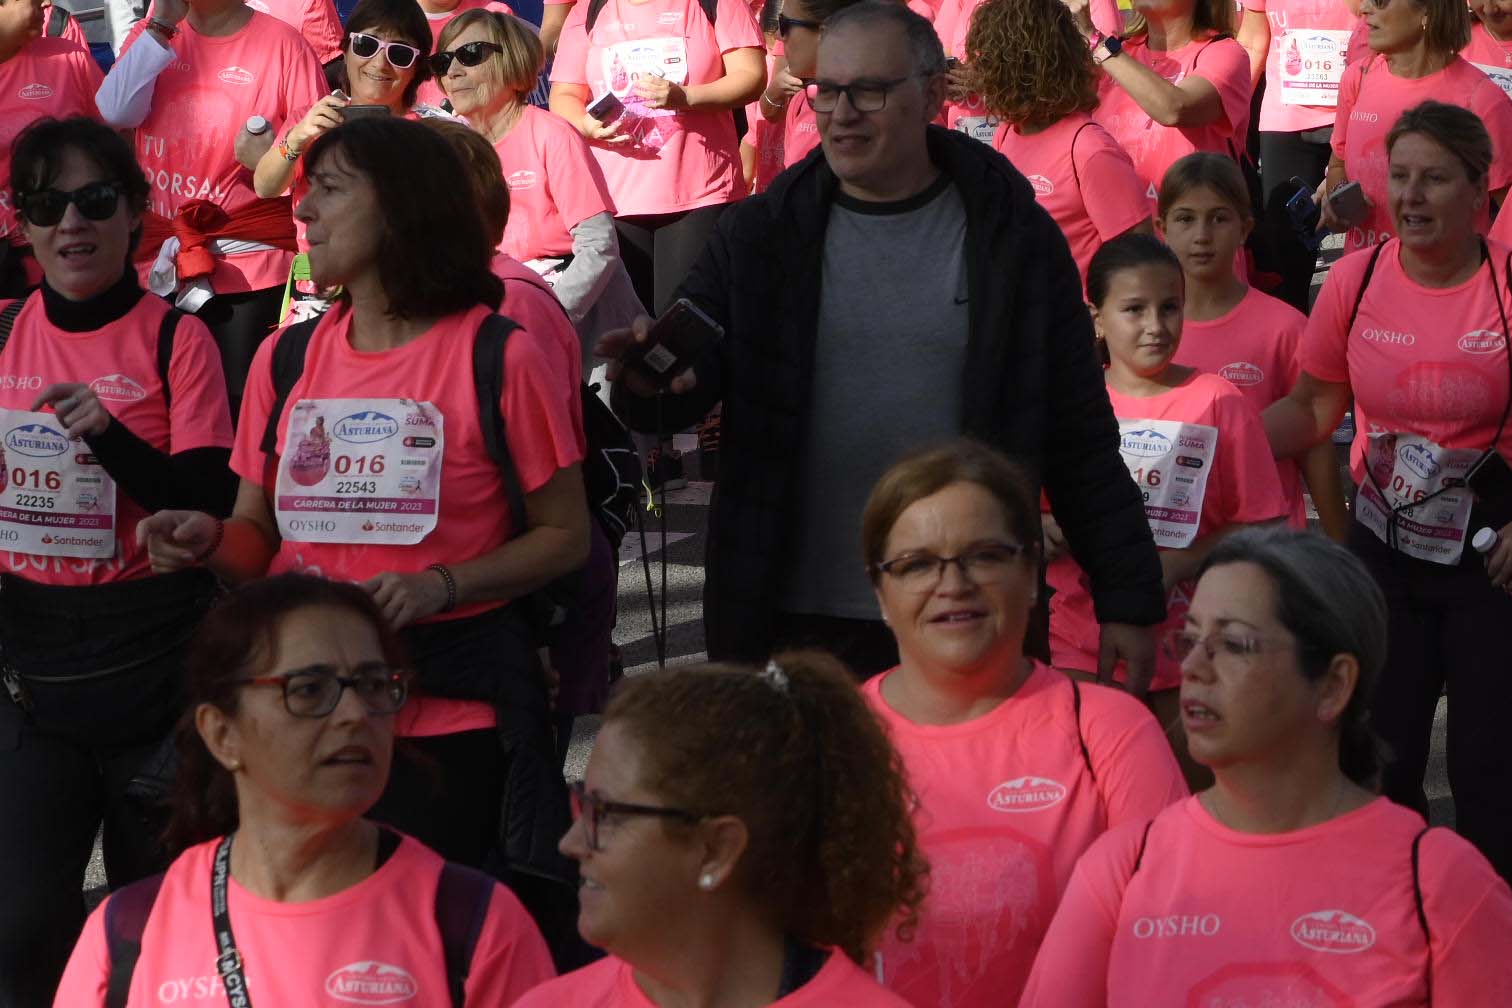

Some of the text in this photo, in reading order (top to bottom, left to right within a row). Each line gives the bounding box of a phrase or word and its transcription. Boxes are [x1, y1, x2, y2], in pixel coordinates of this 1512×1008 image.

[1304, 60, 1332, 71] 016
[144, 135, 165, 158] TU
[1362, 327, 1416, 347] OYSHO
[0, 374, 42, 391] YSHO
[336, 422, 393, 437] ASTURIANA
[10, 434, 65, 452] ASTURIANA
[335, 453, 386, 474] 016
[11, 467, 62, 491] 016
[1134, 467, 1161, 487] 16
[335, 481, 377, 494] 22543
[1392, 475, 1426, 504] 016
[16, 493, 55, 509] 22235
[293, 499, 423, 512] CARRERA DE LA MUJER 2023
[44, 516, 76, 525] MUJER
[289, 519, 425, 533] OYSHO Santander
[53, 535, 105, 547] Santander
[1151, 527, 1188, 539] antander
[993, 789, 1061, 805] ASTURIANA
[1132, 913, 1221, 941] OYSHO
[1296, 922, 1370, 946] ASTURIANA
[332, 977, 411, 996] ASTURIANA
